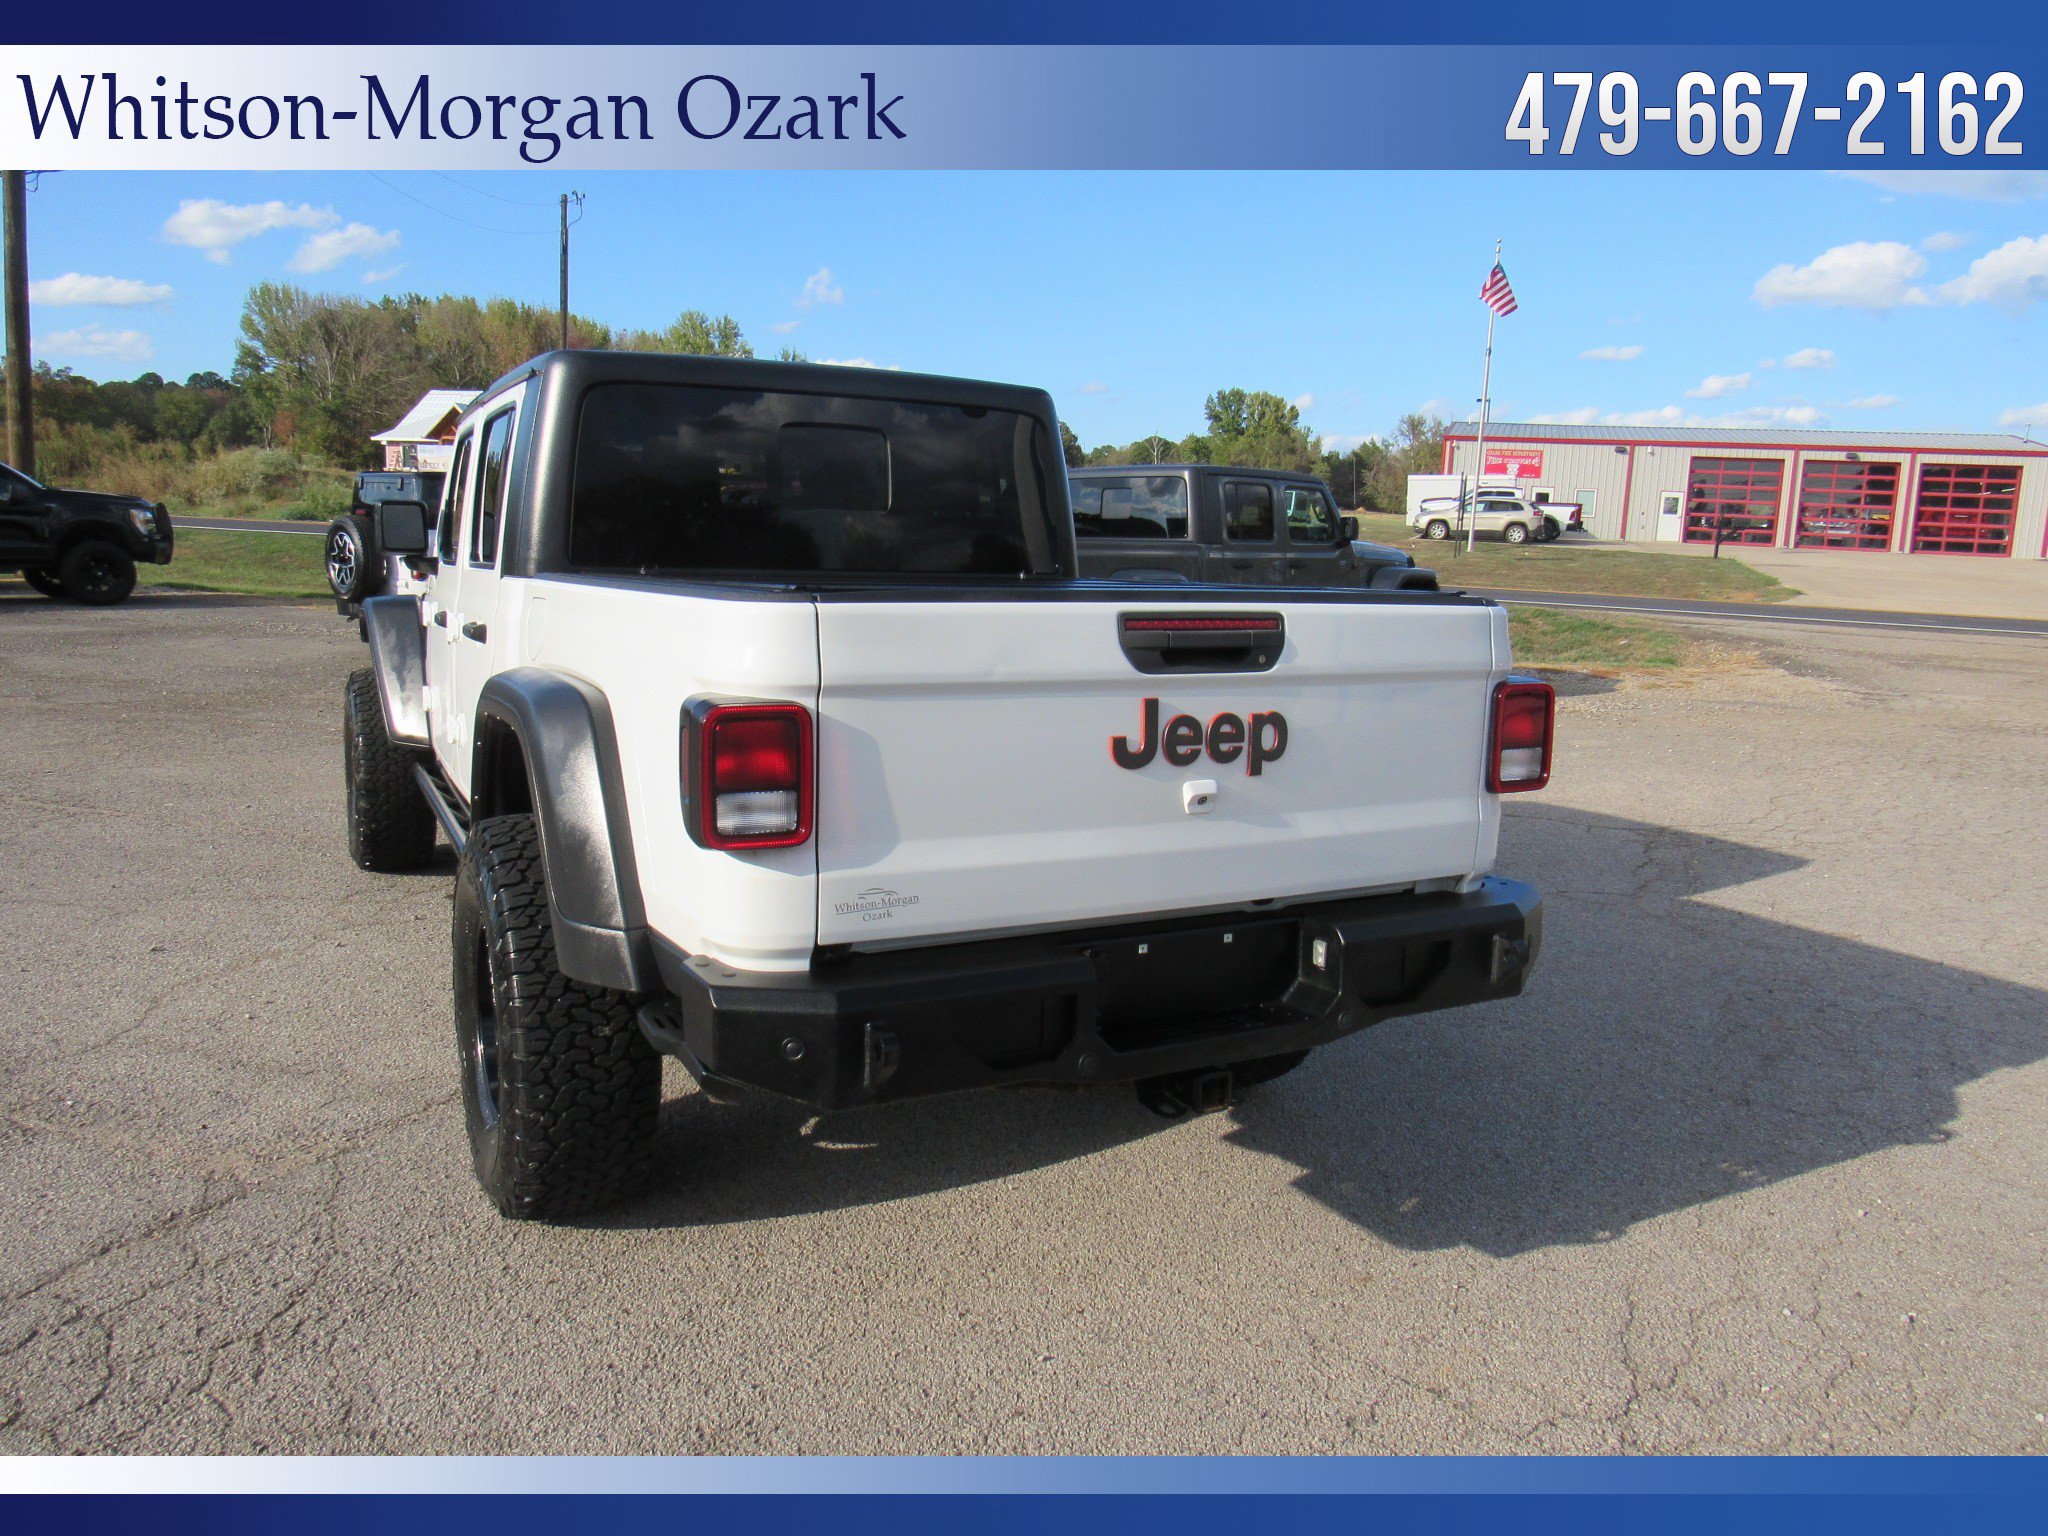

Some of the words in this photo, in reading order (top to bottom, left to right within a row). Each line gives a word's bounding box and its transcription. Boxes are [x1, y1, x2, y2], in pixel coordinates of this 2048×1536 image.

[1109, 697, 1288, 777] Jeep
[834, 894, 919, 914] Whitson-Morgan
[862, 909, 893, 922] Ozark
